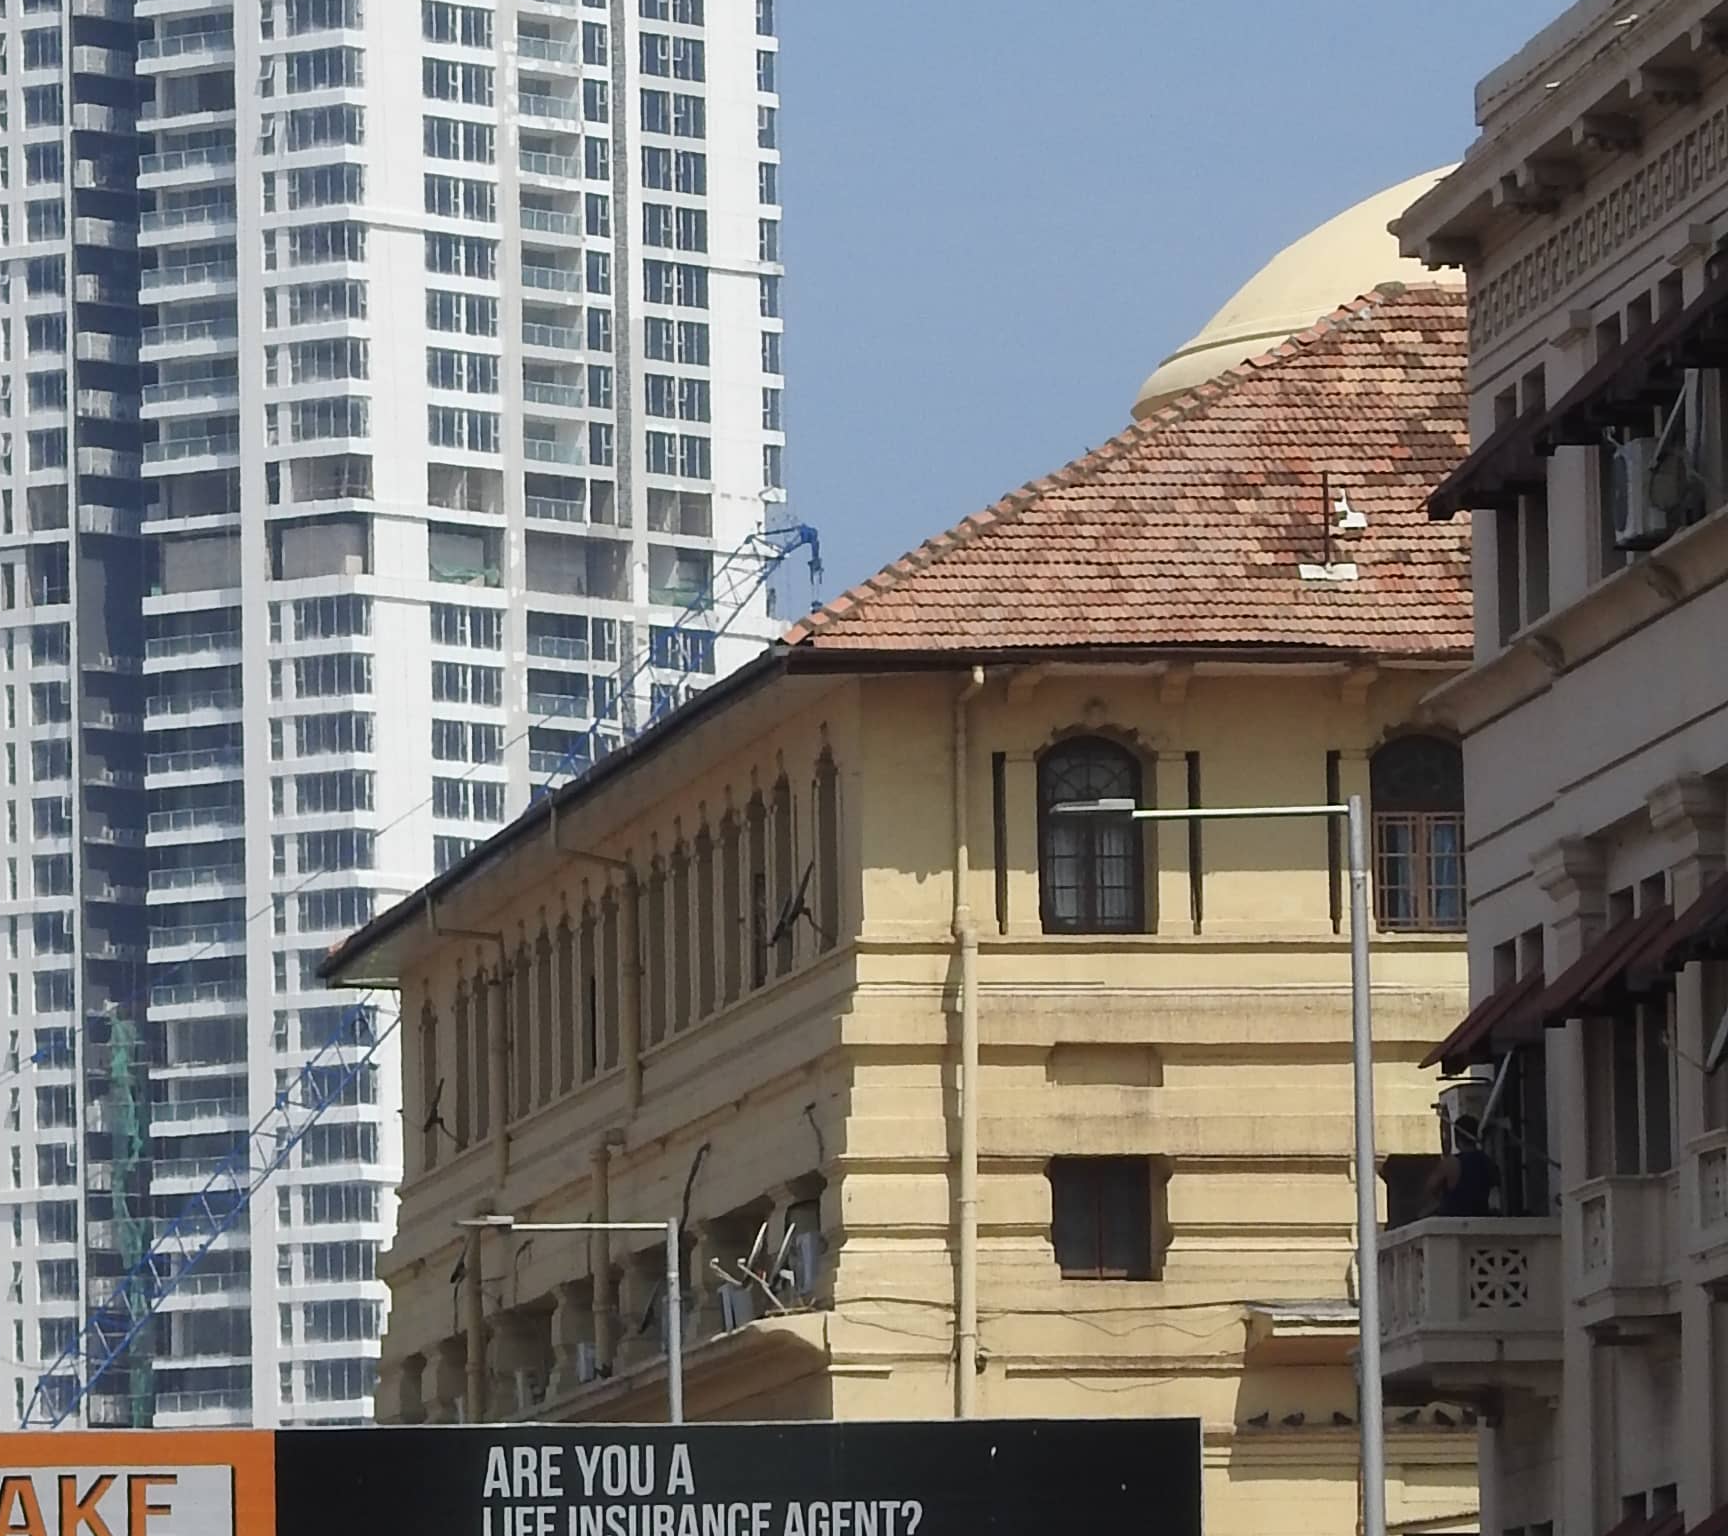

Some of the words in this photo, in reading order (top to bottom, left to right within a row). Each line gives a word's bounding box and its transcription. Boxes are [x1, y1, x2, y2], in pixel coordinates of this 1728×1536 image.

[483, 1446, 564, 1498] ARE
[575, 1445, 655, 1497] YOU
[666, 1443, 696, 1496] A
